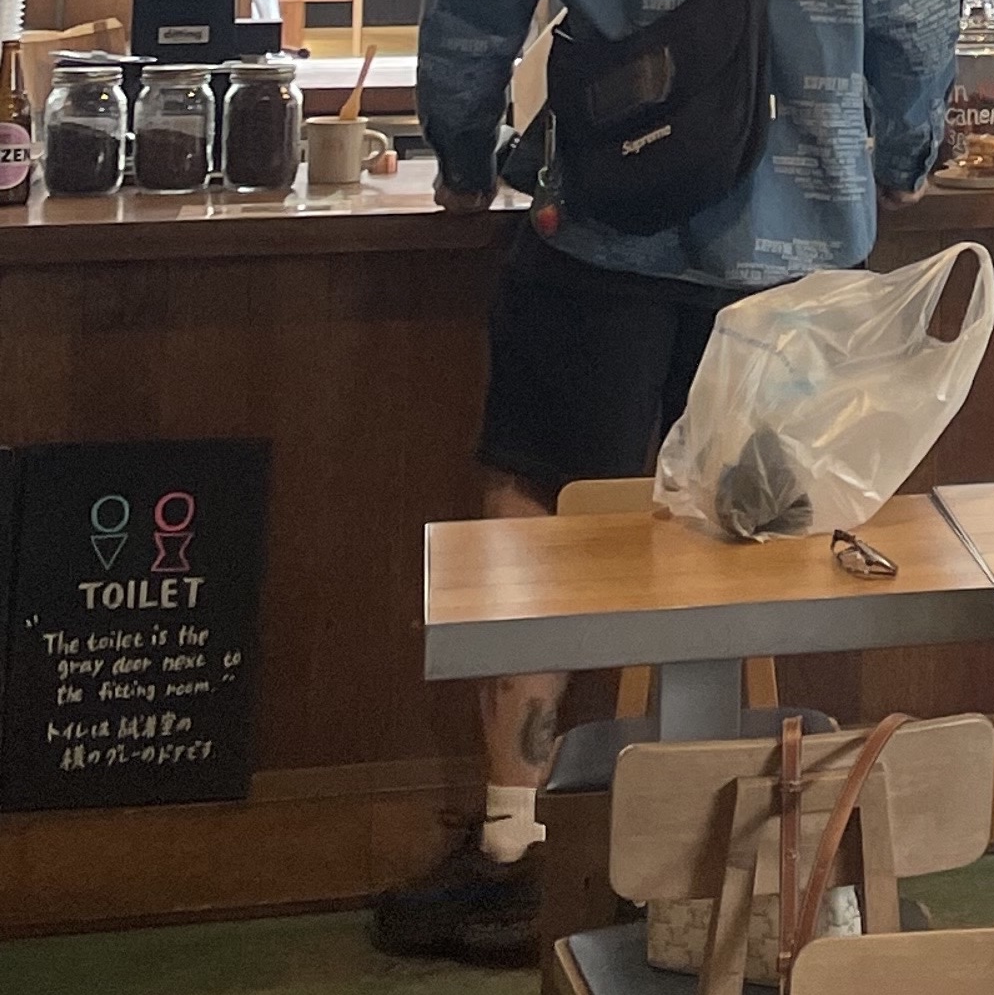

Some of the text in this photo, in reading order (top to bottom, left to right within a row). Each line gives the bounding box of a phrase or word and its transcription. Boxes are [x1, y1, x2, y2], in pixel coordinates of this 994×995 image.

[78, 576, 206, 610] TOILET
[43, 623, 209, 655] The toilet is the
[57, 649, 242, 681] gray door next to
[57, 685, 84, 706] the
[98, 679, 156, 702] fitting
